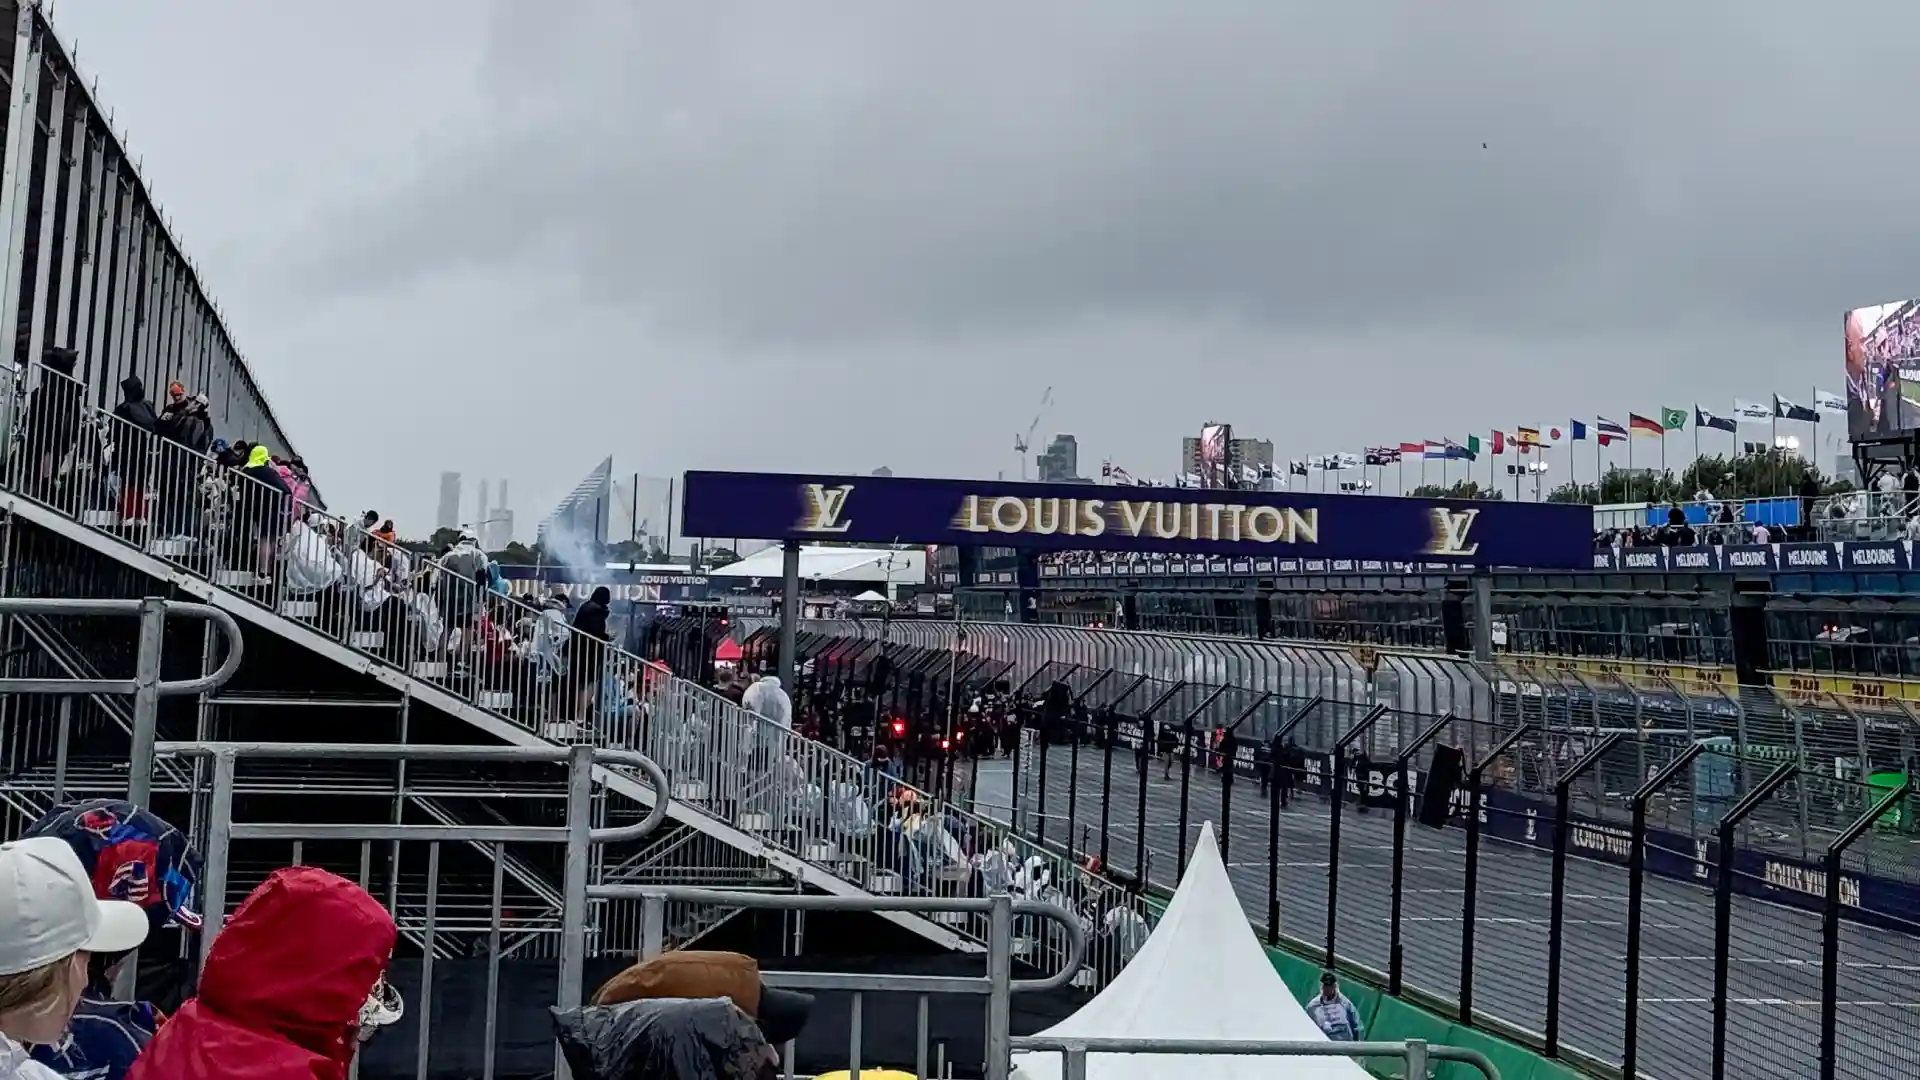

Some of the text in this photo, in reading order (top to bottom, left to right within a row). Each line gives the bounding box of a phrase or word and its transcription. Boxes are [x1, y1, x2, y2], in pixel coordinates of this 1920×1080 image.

[968, 494, 1319, 544] LOUIS VUITTON
[1625, 552, 1658, 567] MELBOURNE
[1675, 552, 1710, 567] MELBOURNE
[1729, 551, 1767, 567] MELBOURNE
[1788, 550, 1829, 566] MELBOURNE
[1852, 548, 1896, 565] MELBOURNE
[640, 575, 709, 585] LOUIS VUITTON
